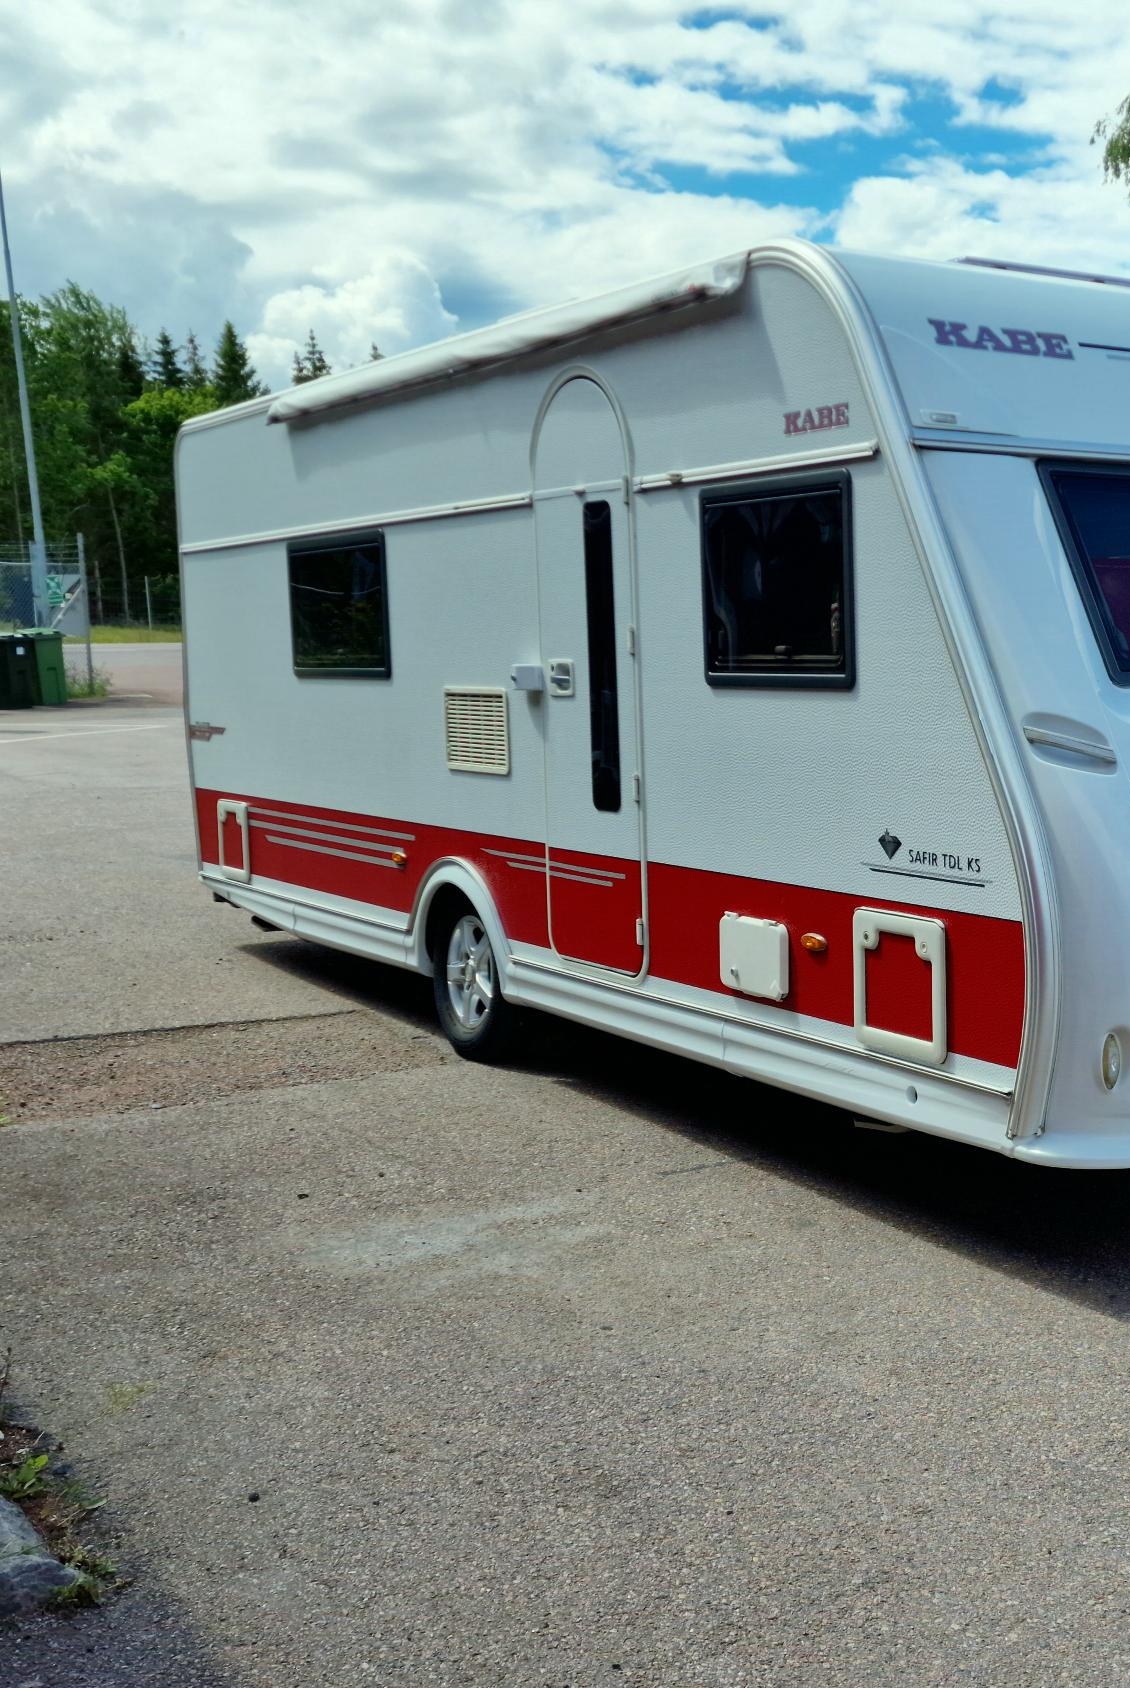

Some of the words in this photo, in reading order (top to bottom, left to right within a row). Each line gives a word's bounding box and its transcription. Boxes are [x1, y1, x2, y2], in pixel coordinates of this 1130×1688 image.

[927, 317, 1075, 361] KABE
[783, 402, 850, 436] KABE
[908, 849, 938, 867] SAFIR
[942, 853, 963, 871] TDL
[967, 857, 981, 873] KS
